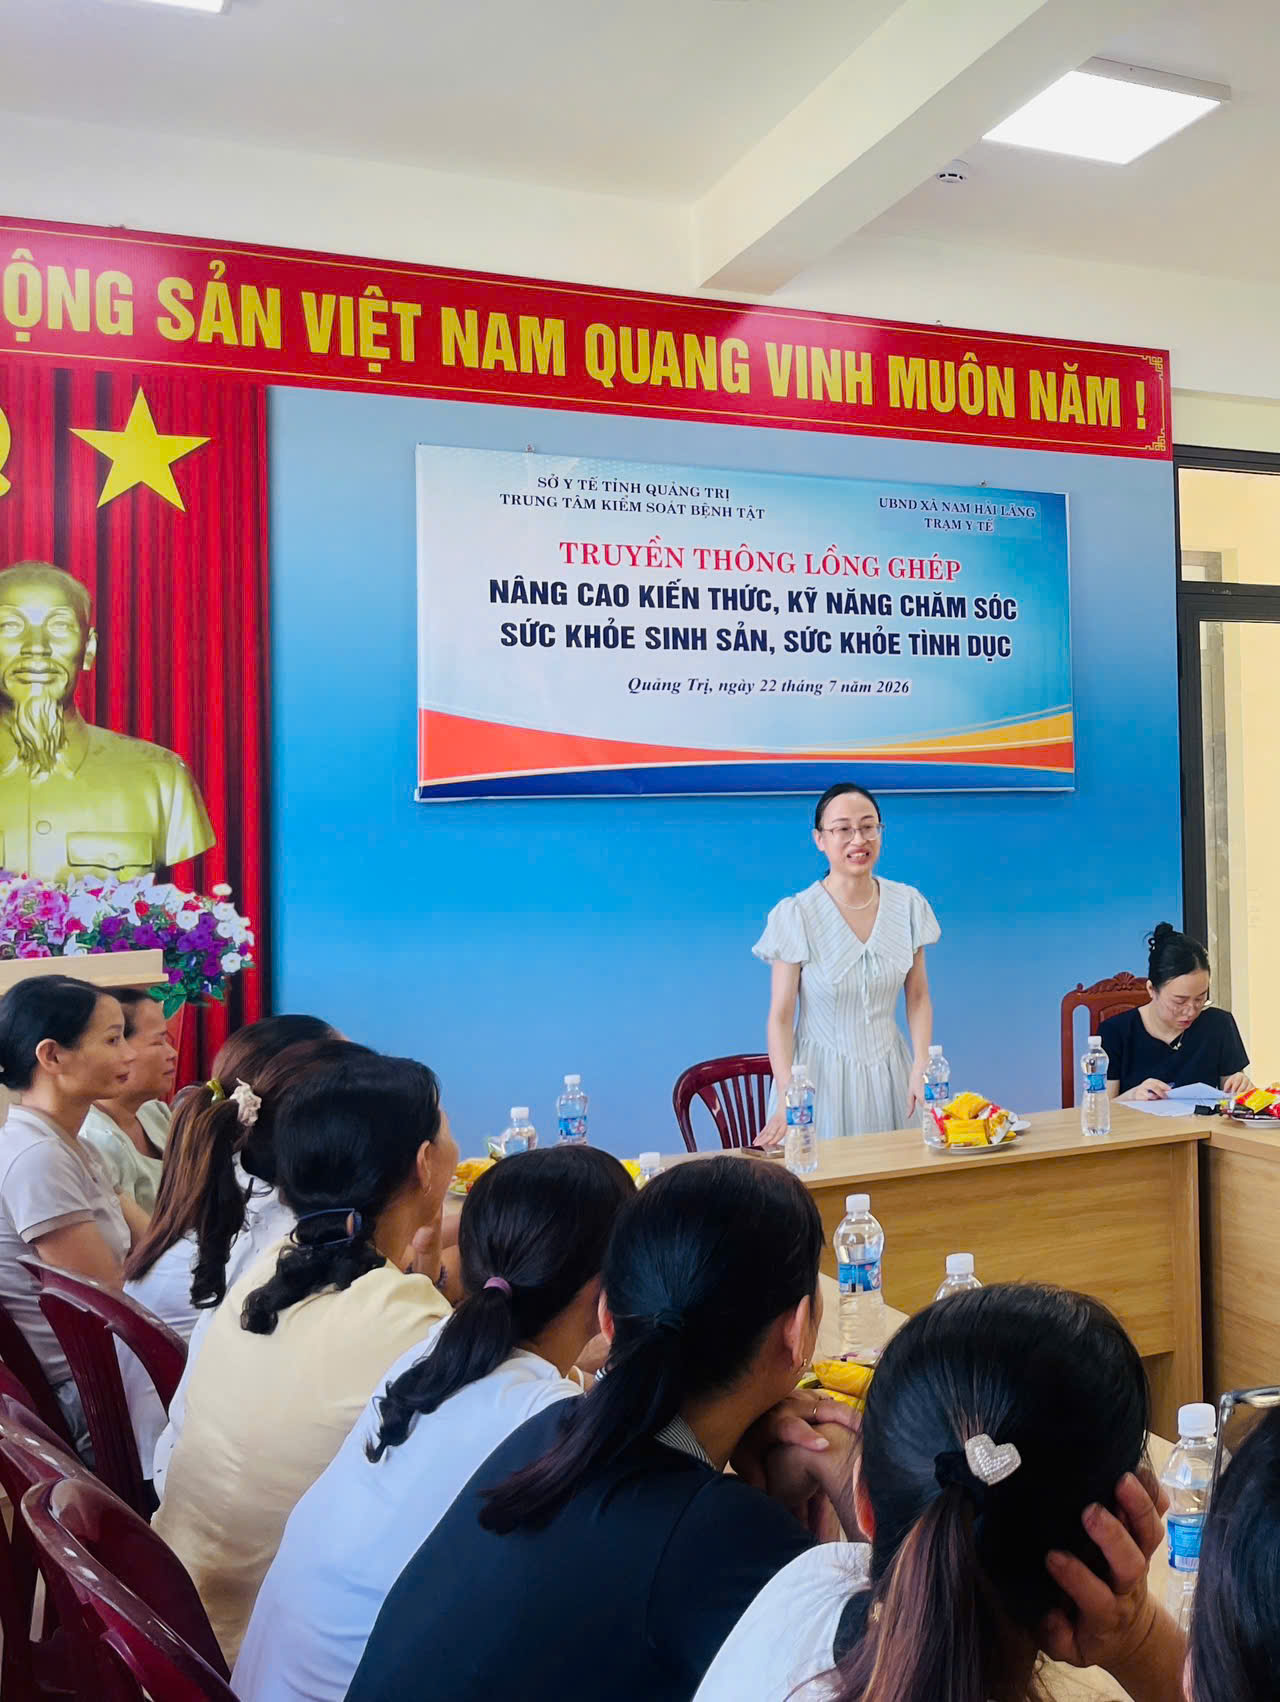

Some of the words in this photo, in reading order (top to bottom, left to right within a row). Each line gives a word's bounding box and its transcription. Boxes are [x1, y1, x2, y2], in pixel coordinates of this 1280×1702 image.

[157, 260, 281, 349] SẢN
[302, 286, 421, 372] VIỆT
[442, 307, 565, 376] NAM
[586, 324, 750, 393] QUANG
[766, 342, 872, 404] VINH
[888, 352, 1015, 417] MUÔN
[1030, 363, 1120, 427] NĂM
[1136, 381, 1145, 429] !
[537, 473, 559, 489] SỞ
[563, 479, 573, 489] Y
[578, 477, 597, 491] TẾ
[602, 478, 640, 493] TỈNH
[646, 482, 699, 496] QUẢNG
[704, 487, 730, 501] TRỊ
[500, 494, 557, 507] TRUNG
[562, 498, 596, 509] TÂM
[602, 495, 641, 512] KIỂM
[646, 501, 686, 515] SOÁT
[691, 503, 731, 518] BỆNH
[737, 505, 765, 521] TẬT
[879, 498, 917, 510] UBND
[942, 502, 969, 513] NAM
[975, 500, 997, 515] HẢI
[924, 517, 961, 532] TRẠM
[965, 520, 976, 531] Y
[977, 518, 994, 532] TẾ
[559, 535, 685, 569] TRUYỀN
[692, 543, 797, 574] THÔNG
[804, 544, 880, 577] LỒNG
[888, 553, 961, 581] GHÉP
[490, 575, 567, 605] NÂNG
[578, 583, 629, 607] CAO
[639, 579, 699, 609] KIẾN
[708, 584, 779, 615] THỨC,
[788, 587, 817, 613] KỸ
[826, 588, 892, 615] NĂNG
[901, 592, 966, 618] CHĂM
[975, 594, 1016, 619] SÓC
[501, 618, 555, 647] SỨC
[566, 617, 635, 649] KHỎE
[645, 627, 707, 650] SINH
[717, 621, 775, 655] SẢN,
[784, 626, 831, 653] SỨC
[840, 625, 900, 654] KHỎE
[909, 629, 959, 655] TÌNH
[968, 636, 1010, 661] DỤC
[628, 678, 681, 694] Quảng
[688, 678, 712, 694] Trị,
[719, 679, 755, 695] ngày
[760, 680, 776, 691] 22
[782, 680, 823, 695] tháng
[830, 680, 837, 691] 7
[841, 681, 871, 692] năm
[877, 681, 908, 693] 2026
